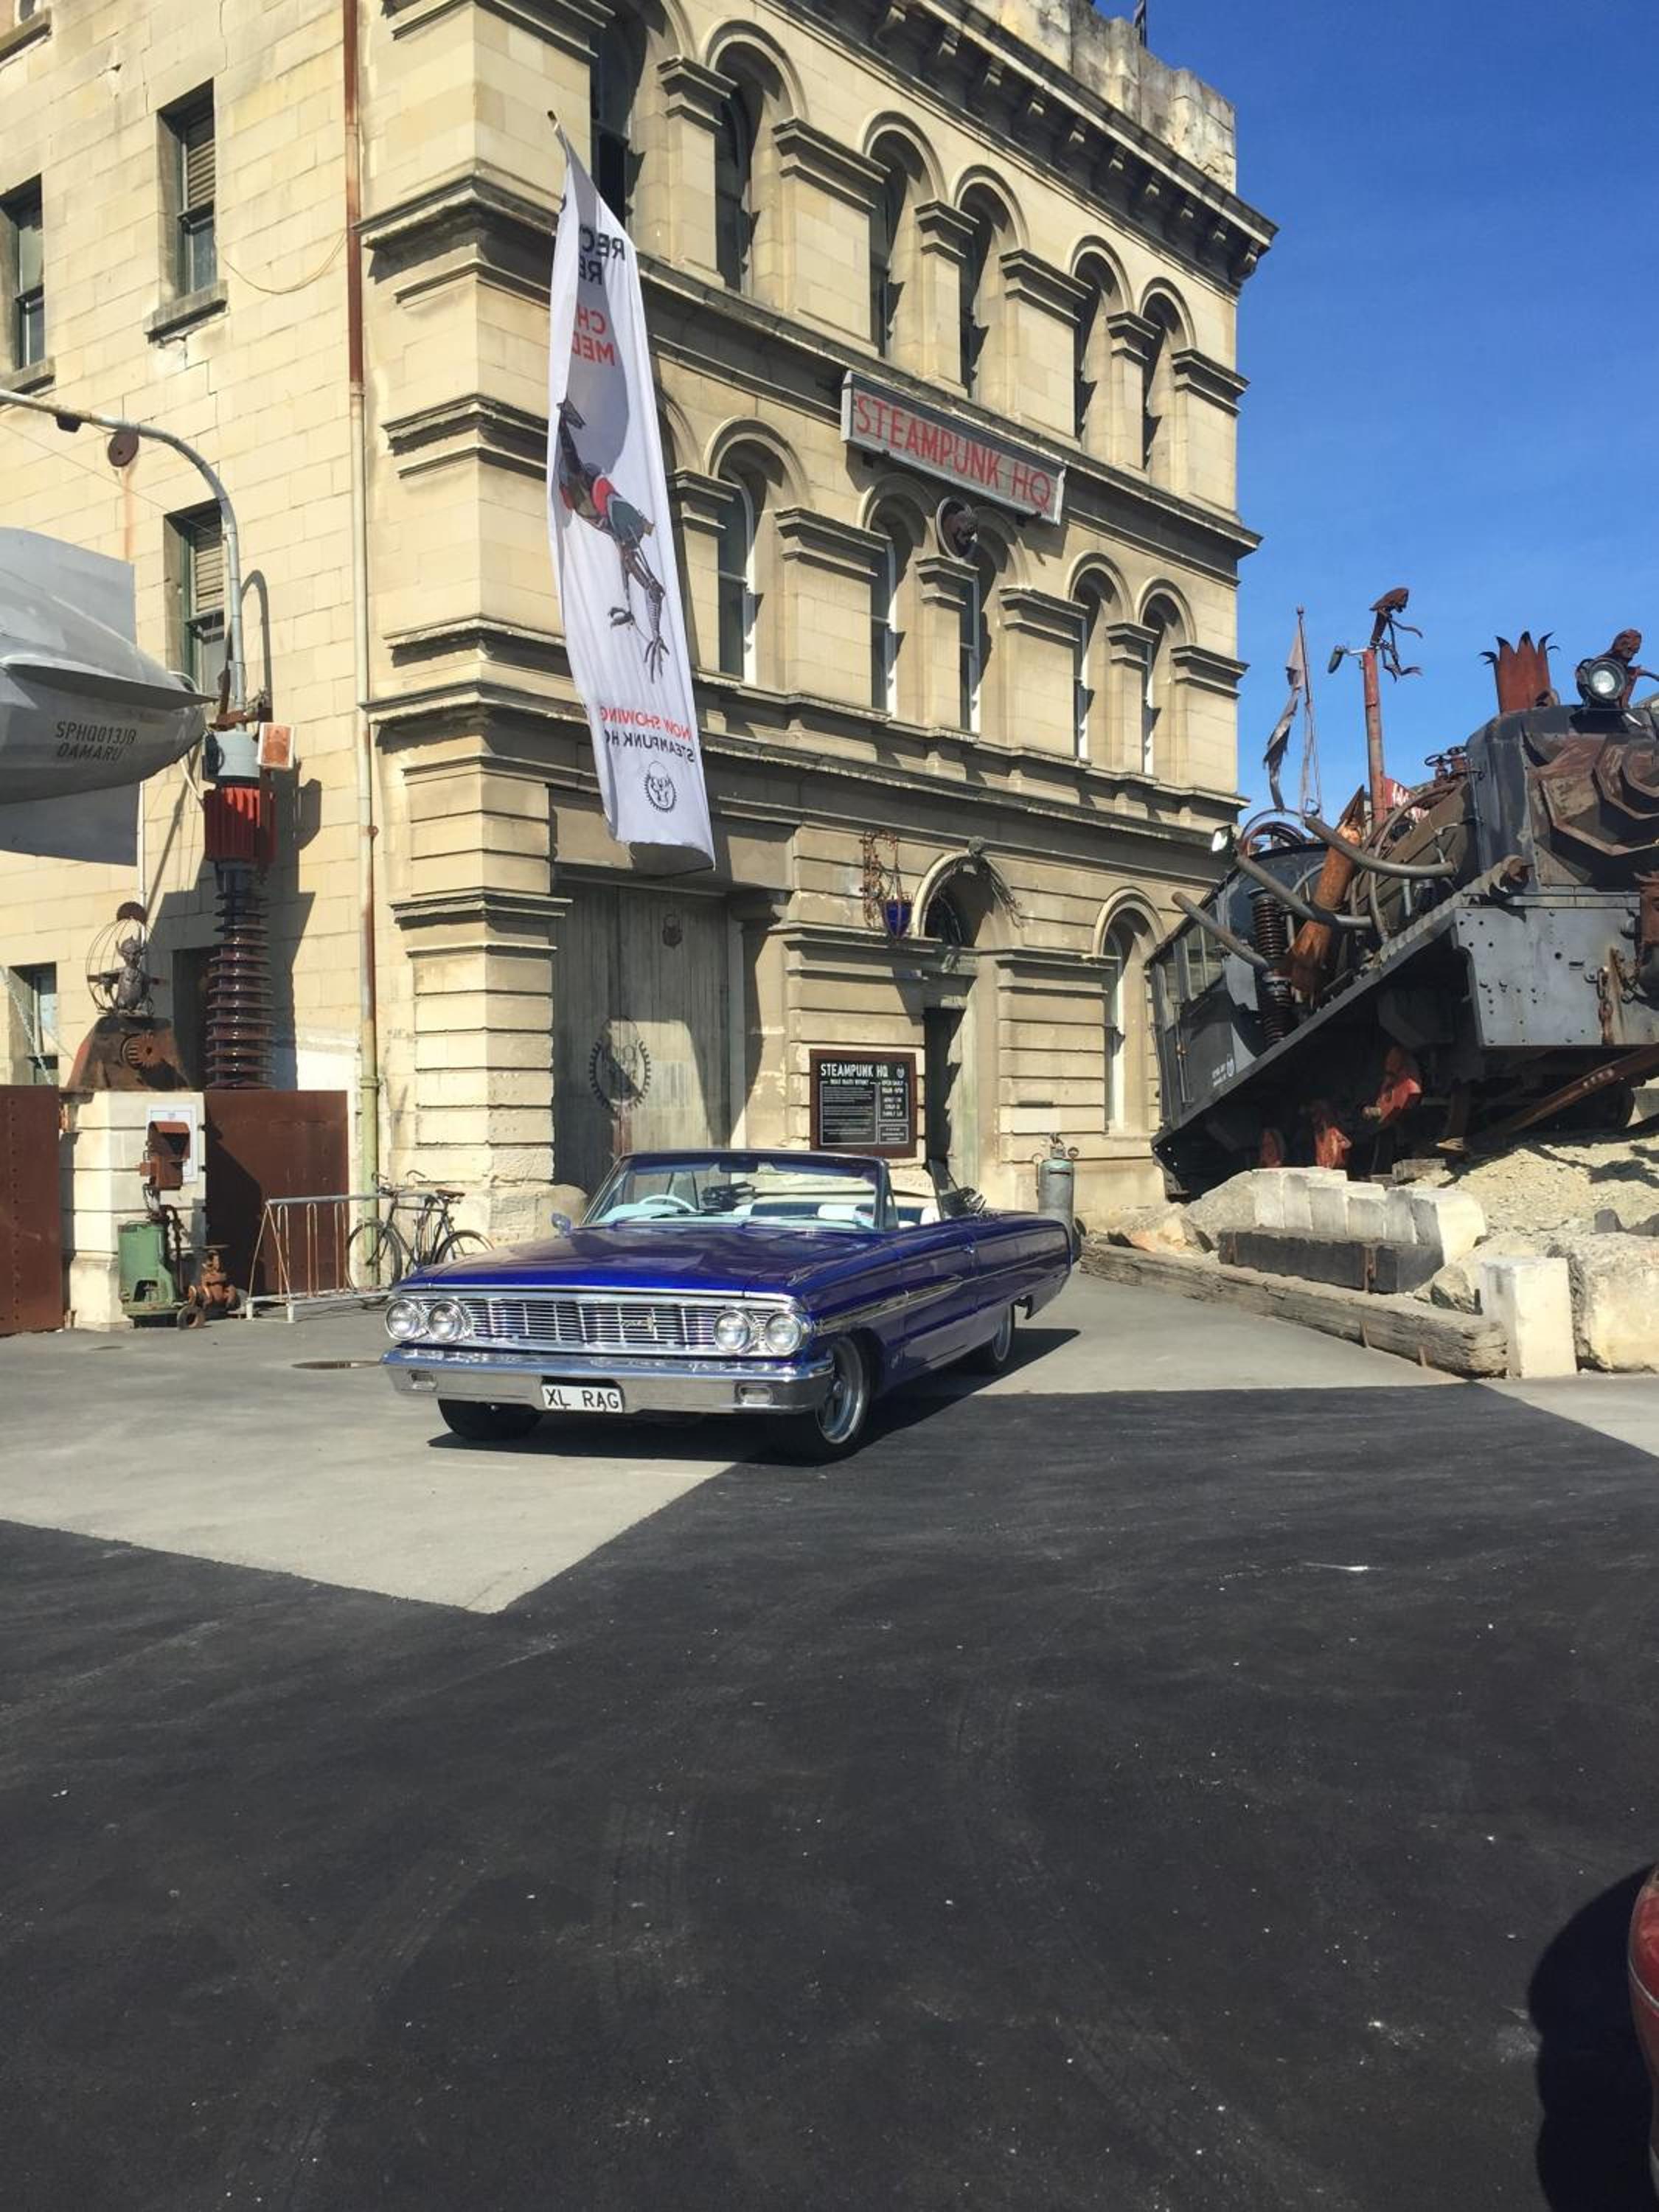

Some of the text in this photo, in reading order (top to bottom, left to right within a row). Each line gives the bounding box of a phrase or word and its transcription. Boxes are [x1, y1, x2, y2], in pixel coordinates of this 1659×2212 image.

[855, 394, 1050, 513] STEAMPUNK HQ
[821, 1063, 888, 1077] STEAMPUNK HQ
[546, 1388, 619, 1409] XL RAG
